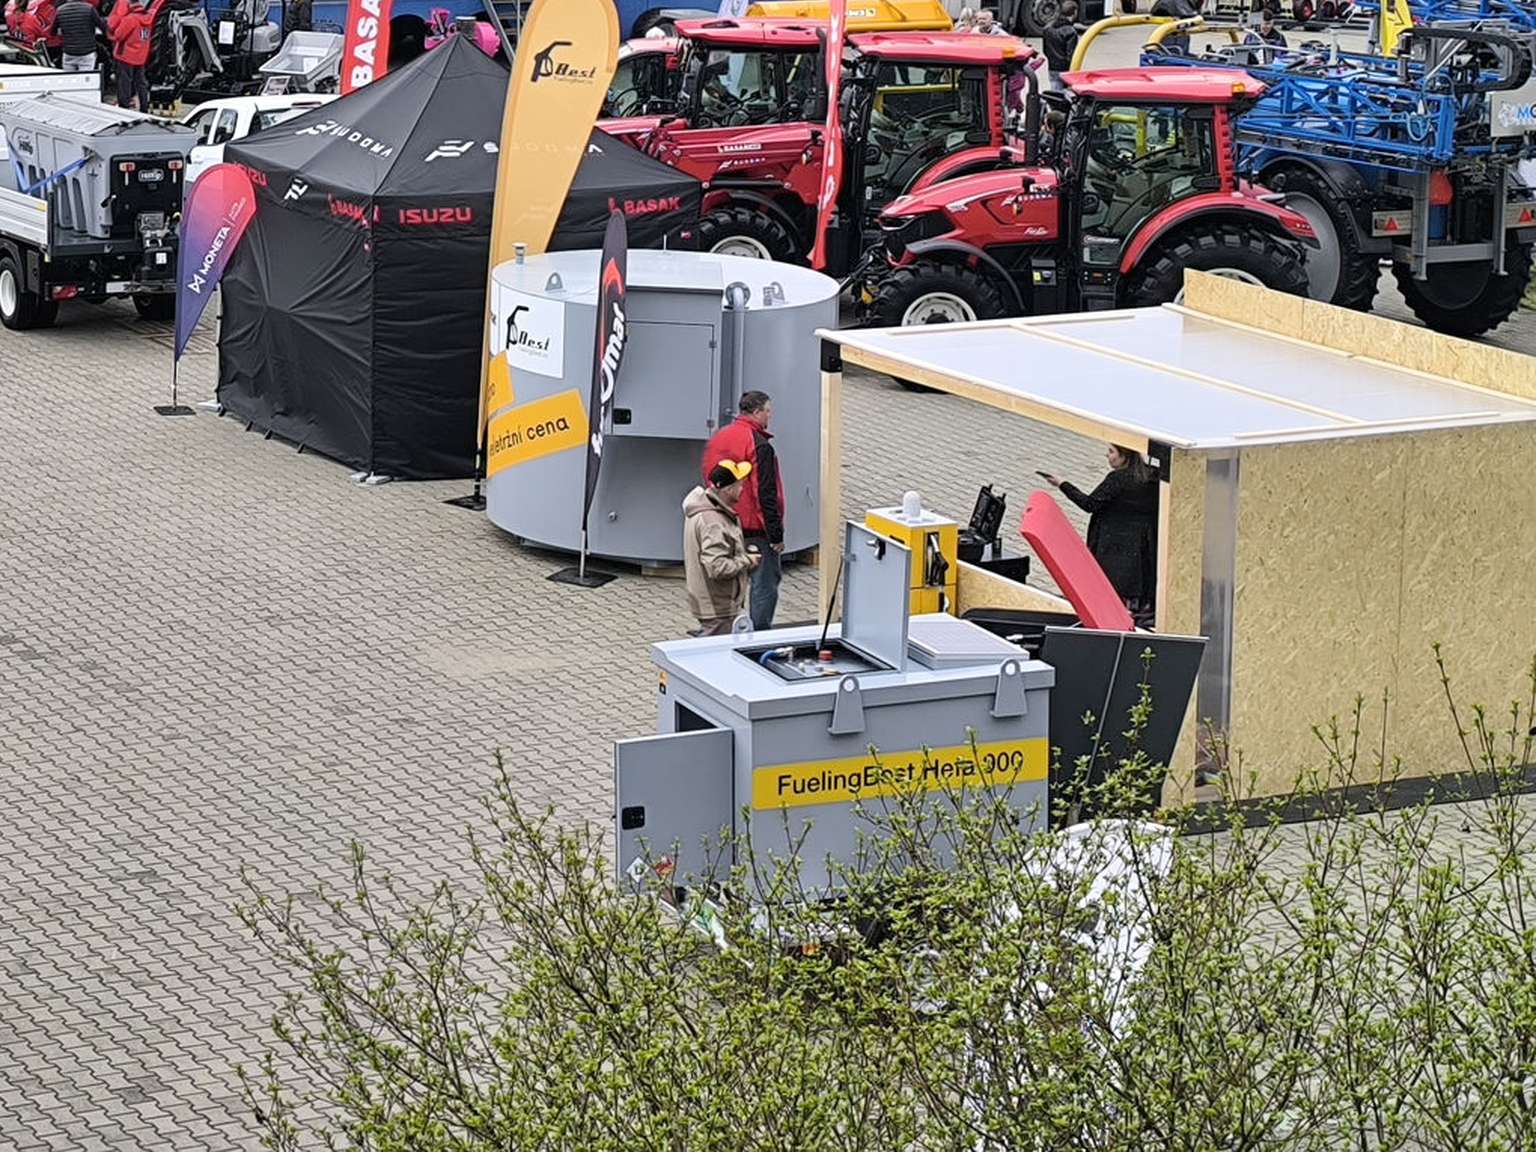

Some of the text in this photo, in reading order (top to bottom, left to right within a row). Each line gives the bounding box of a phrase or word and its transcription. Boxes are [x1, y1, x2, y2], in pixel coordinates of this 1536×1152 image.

[399, 207, 472, 225] ISUZU
[623, 196, 681, 215] BASAK
[199, 226, 231, 276] MONETA
[526, 416, 570, 441] cena
